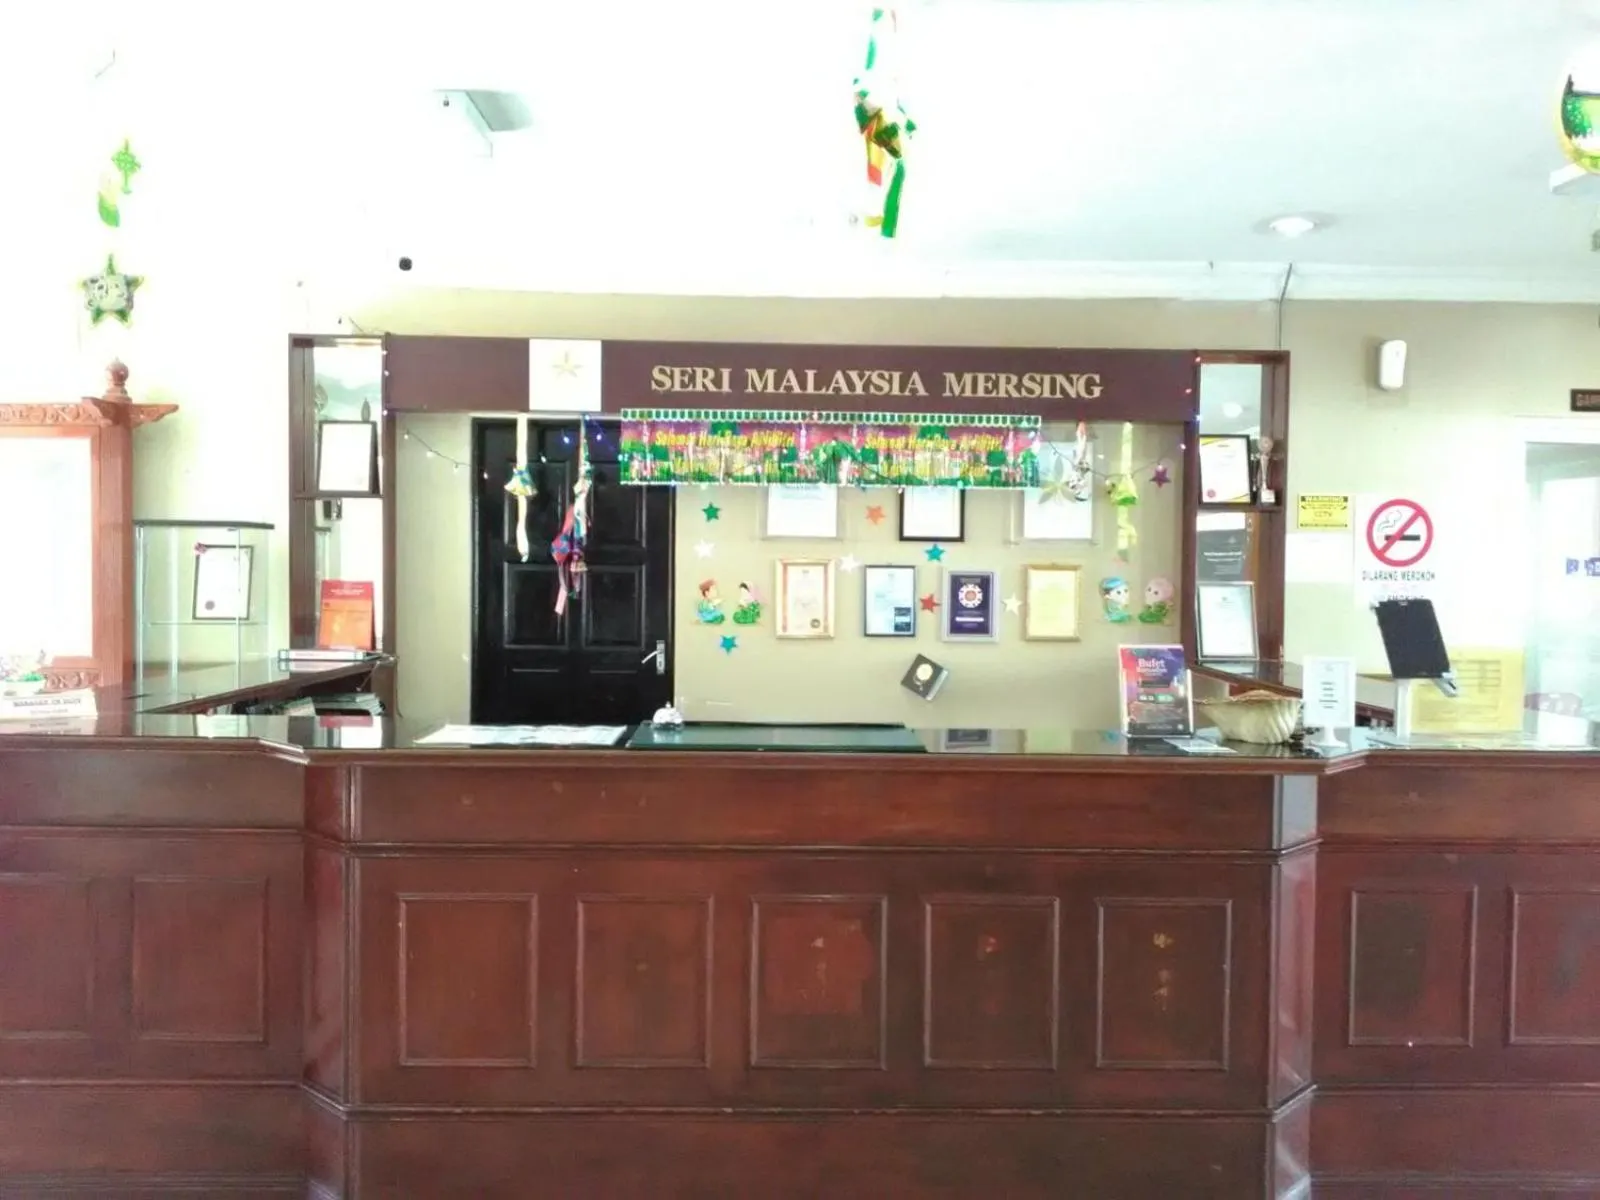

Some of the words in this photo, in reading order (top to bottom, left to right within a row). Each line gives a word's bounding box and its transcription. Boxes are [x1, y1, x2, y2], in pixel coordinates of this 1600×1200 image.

[651, 365, 732, 393] SERI
[745, 368, 929, 396] MALAYSIA
[942, 372, 1104, 399] MERSING
[1362, 570, 1398, 581] DILARANG
[1400, 570, 1436, 581] MEROKOK
